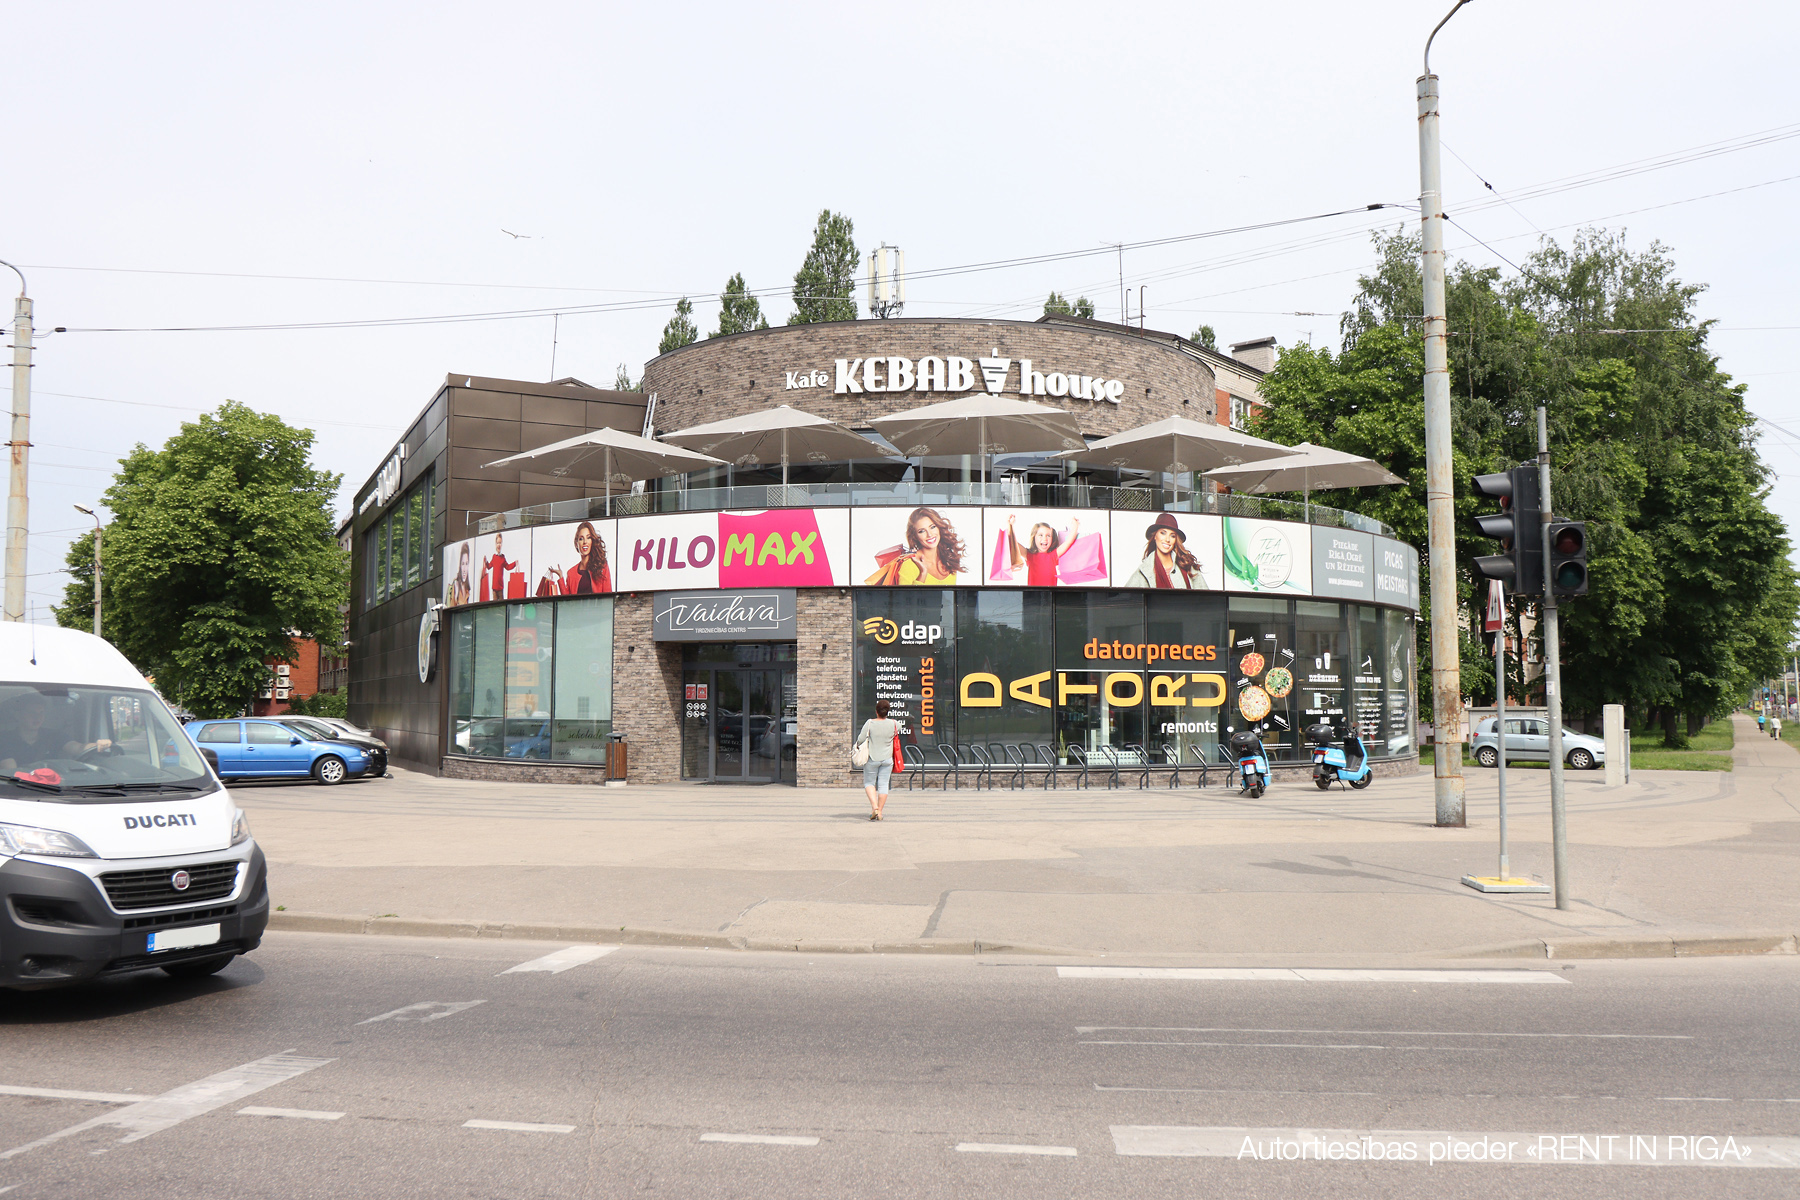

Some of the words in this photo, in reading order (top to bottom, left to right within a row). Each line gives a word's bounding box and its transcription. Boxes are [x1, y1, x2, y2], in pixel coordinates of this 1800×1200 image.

[786, 370, 829, 390] Kafē
[834, 356, 975, 394] KEBAB
[1019, 358, 1125, 404] house
[632, 535, 716, 572] KILO
[723, 531, 818, 566] MAX
[1260, 538, 1282, 550] TEA
[1254, 552, 1287, 565] MINT
[1384, 550, 1403, 570] PICAS
[1377, 573, 1408, 595] MEISTARS
[656, 596, 793, 626] Vaidava
[901, 620, 941, 644] dap
[1084, 638, 1216, 664] datorpreces
[918, 657, 934, 735] remonts
[960, 670, 1227, 708] DATORU
[1161, 720, 1217, 734] remonts
[123, 814, 197, 829] DUCATI
